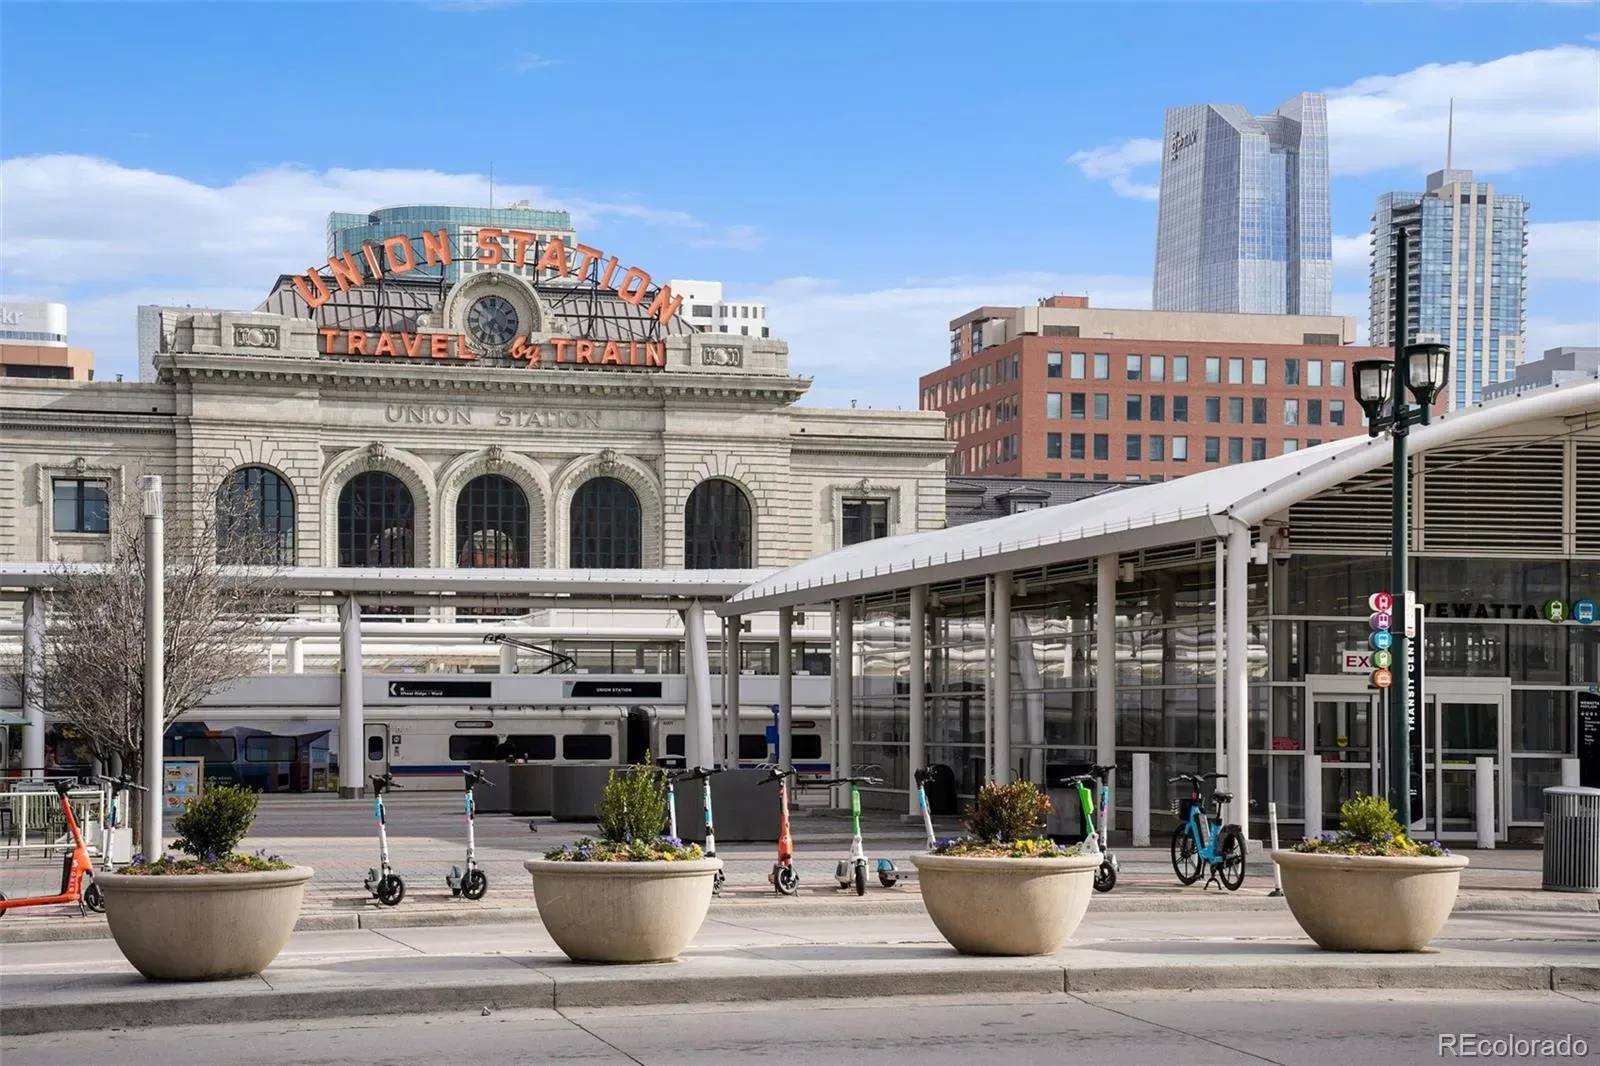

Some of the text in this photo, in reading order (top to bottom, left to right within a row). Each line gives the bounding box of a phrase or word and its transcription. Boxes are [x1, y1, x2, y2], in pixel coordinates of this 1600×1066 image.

[292, 228, 684, 326] UNION STATION
[0, 306, 23, 324] kr
[319, 328, 665, 370] TRAVEL by TRAIN
[384, 404, 600, 428] UNION STATION
[1407, 678, 1415, 733] TRANSIT
